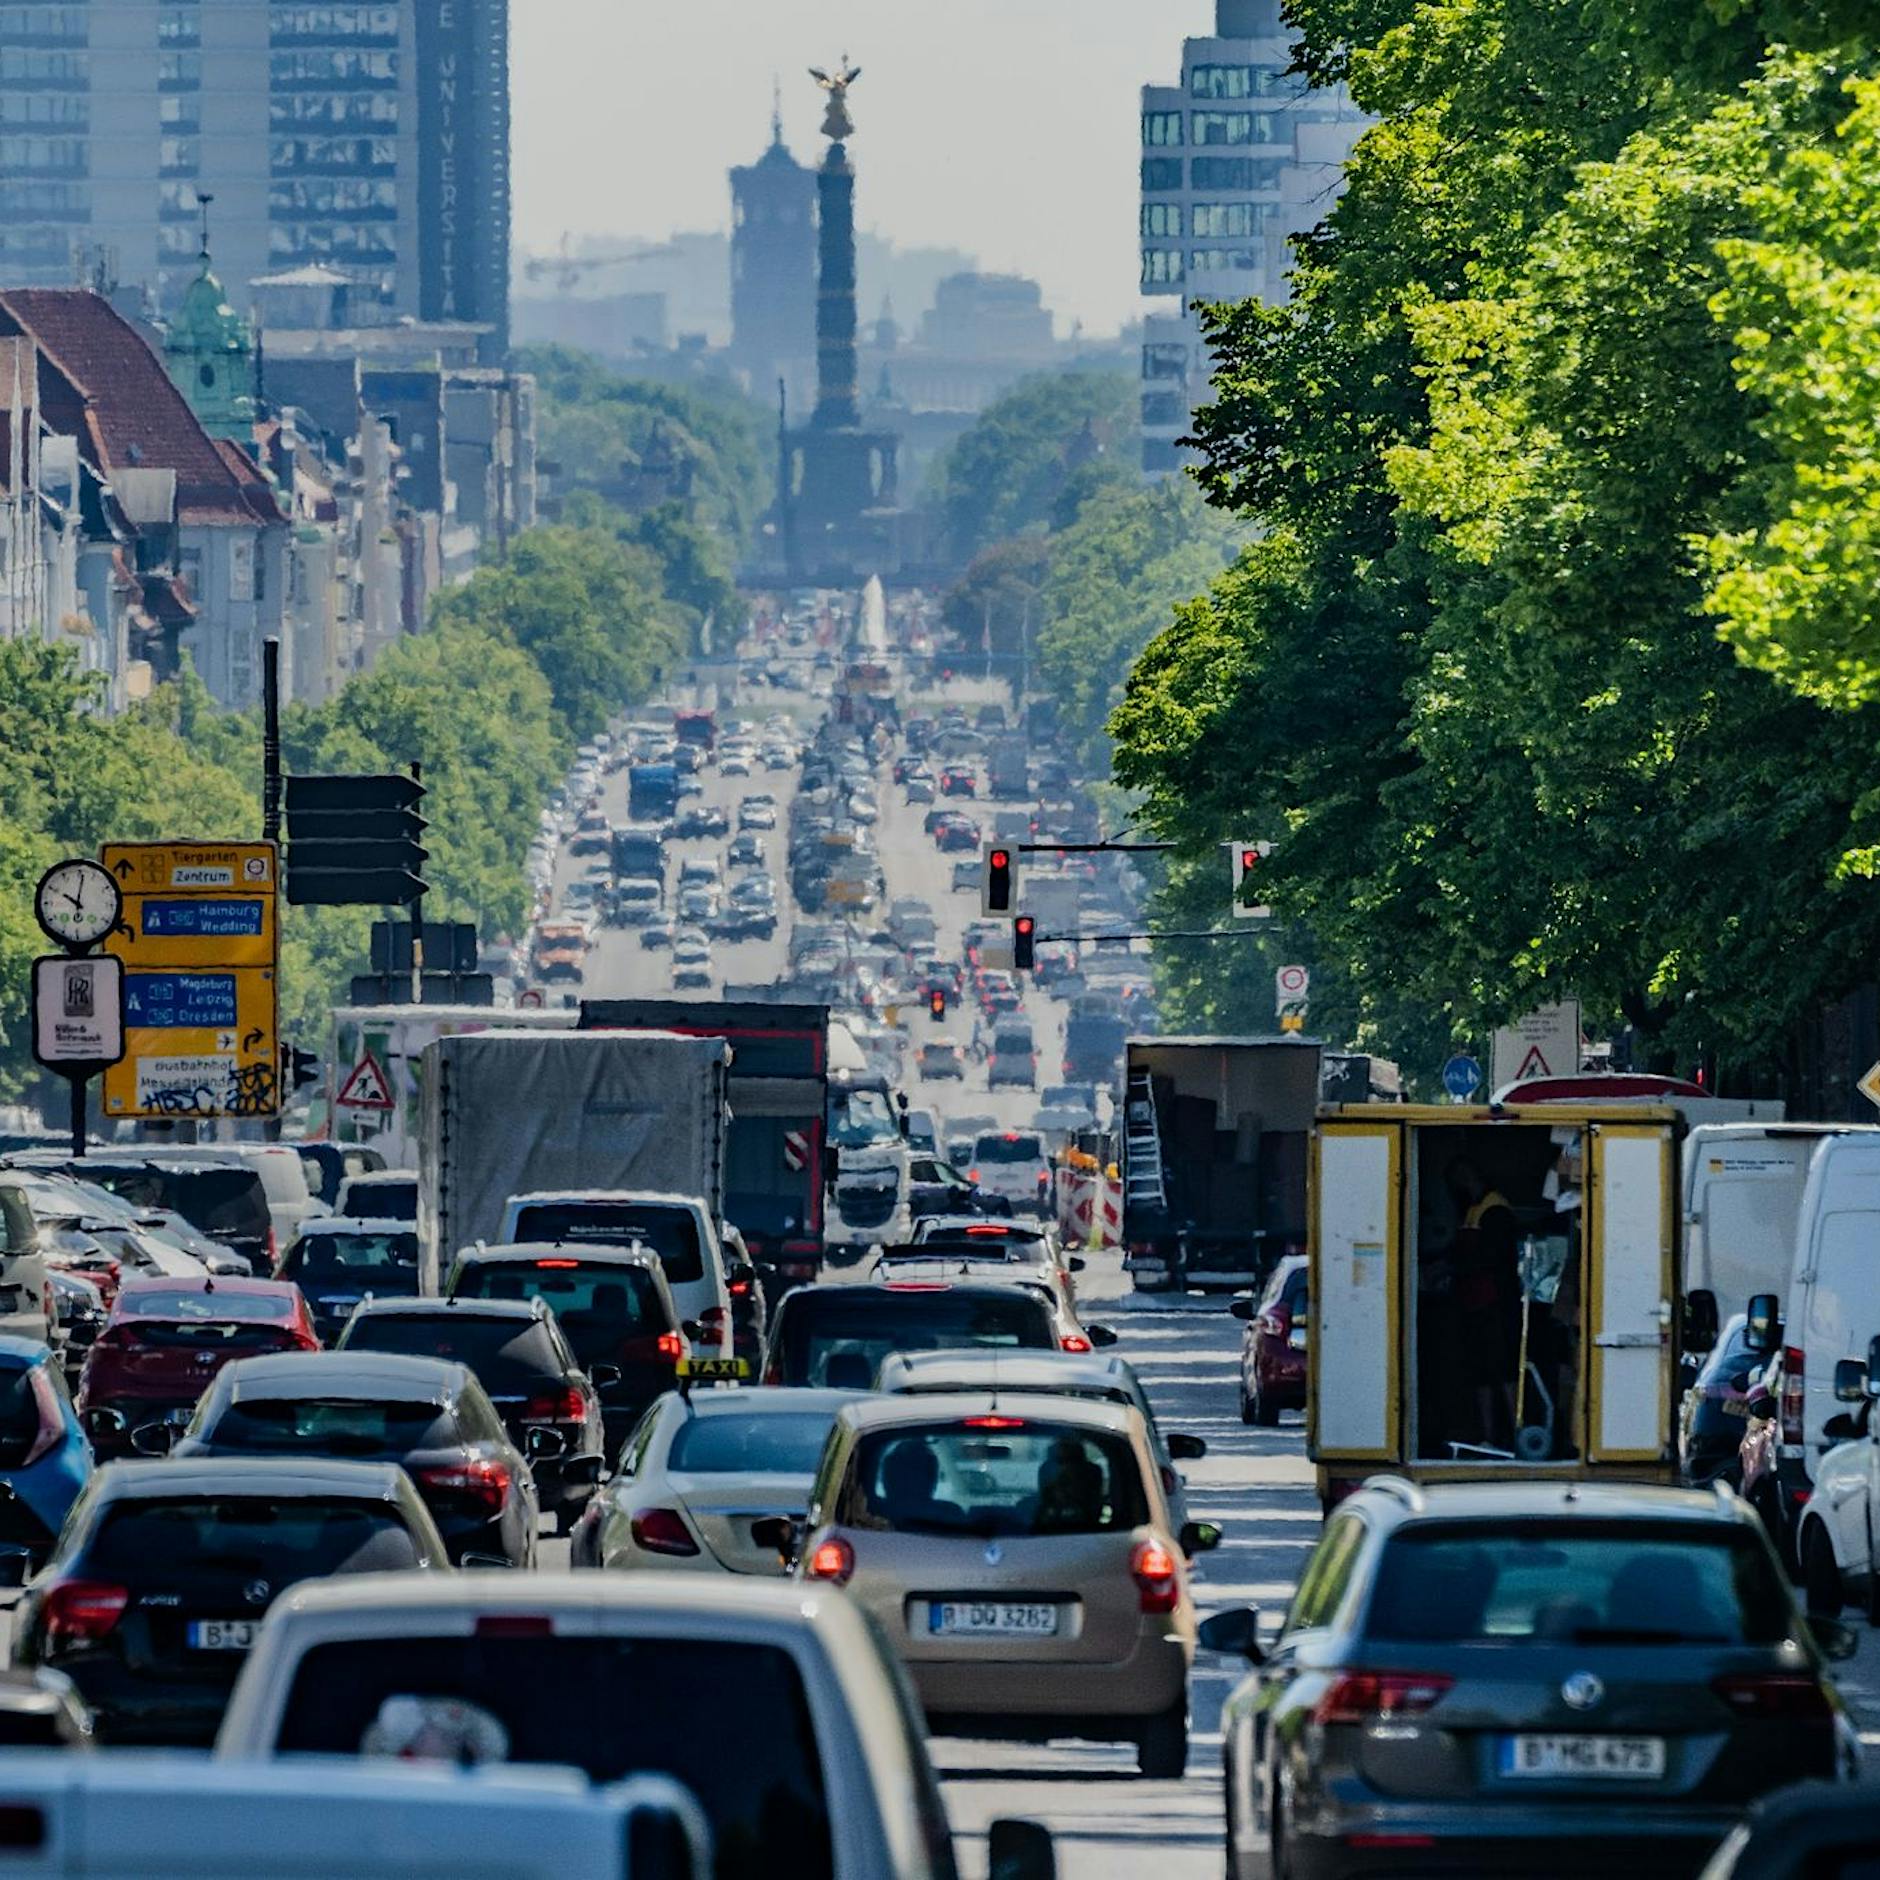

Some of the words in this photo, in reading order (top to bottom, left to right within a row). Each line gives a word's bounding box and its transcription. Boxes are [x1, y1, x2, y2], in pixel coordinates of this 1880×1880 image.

[172, 851, 238, 865] Tiergarten
[175, 871, 230, 883] Zentrum
[199, 904, 260, 920] Hamburg
[200, 920, 257, 933] Wedding
[179, 977, 233, 991] Magdeburg
[187, 993, 234, 1008] Leipzig
[178, 1009, 235, 1022] Dresden
[691, 1360, 737, 1373] TAXI
[207, 1625, 221, 1646] B
